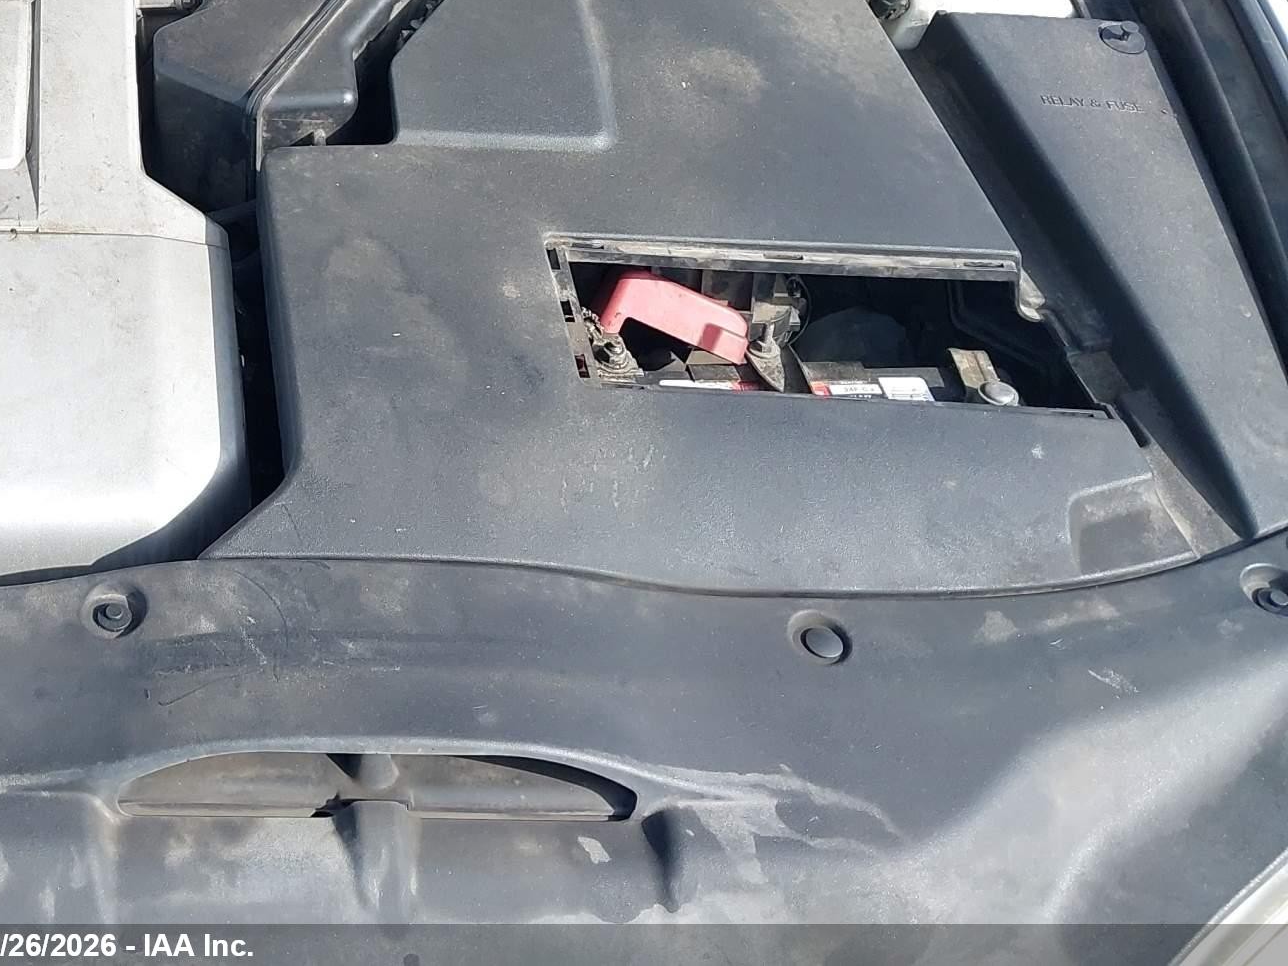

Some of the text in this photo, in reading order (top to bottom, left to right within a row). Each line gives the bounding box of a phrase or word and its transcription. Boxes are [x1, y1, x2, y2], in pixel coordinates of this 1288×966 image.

[1039, 94, 1145, 113] RELAY & FUSE
